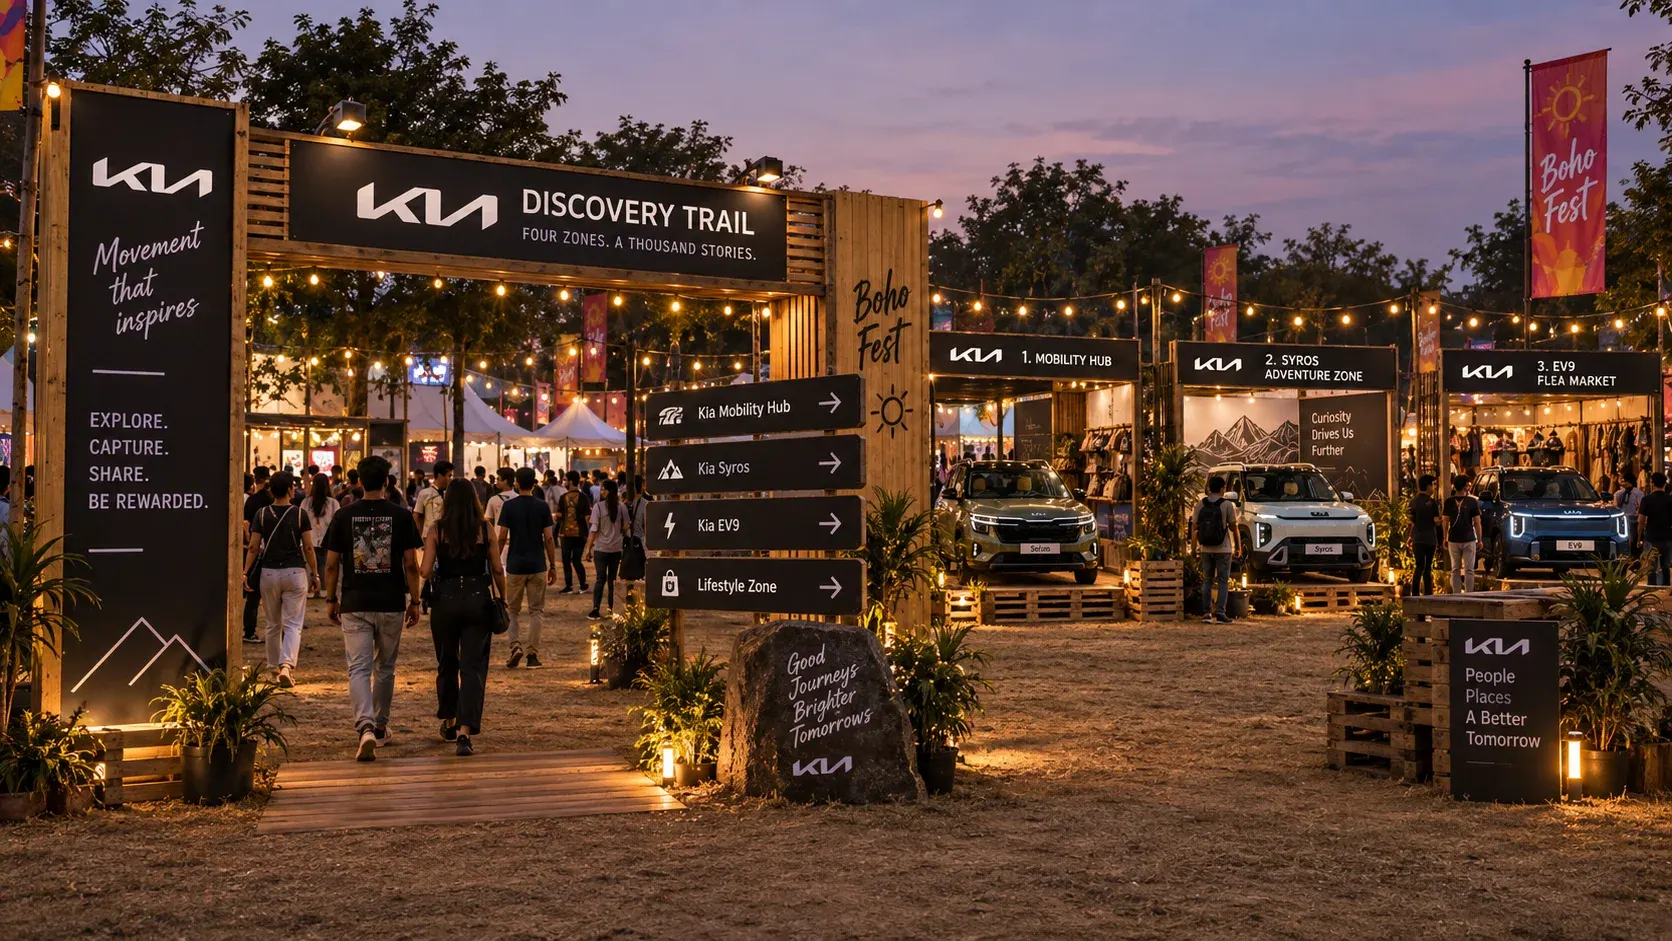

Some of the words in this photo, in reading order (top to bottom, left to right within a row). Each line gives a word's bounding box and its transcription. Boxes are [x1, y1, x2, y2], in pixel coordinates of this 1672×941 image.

[1540, 137, 1598, 194] Boho
[523, 188, 675, 228] DISCOVERY
[683, 205, 755, 236] TRAIL
[1543, 176, 1598, 233] Fest
[93, 221, 205, 275] Movement
[523, 227, 557, 242] FOUR
[563, 231, 609, 247] ZONES.
[615, 236, 623, 248] A
[629, 237, 696, 254] THOUSAND
[701, 244, 756, 260] STORIES.
[109, 268, 158, 306] that
[853, 268, 912, 324] Boho
[115, 298, 200, 340] inspires
[858, 317, 912, 371] Fest
[1022, 351, 1032, 365] 1.
[1036, 353, 1086, 365] MOBILITY
[1090, 356, 1111, 366] HUB
[1266, 354, 1276, 365] 2.
[1282, 355, 1319, 366] SYROS
[1538, 361, 1548, 371] 3.
[1553, 361, 1575, 371] EV9
[1265, 369, 1330, 380] ADVENTURE
[1334, 371, 1362, 381] ZONE
[1538, 375, 1565, 386] FLEA
[1570, 376, 1616, 386] MARKET
[699, 407, 715, 419] Kia
[720, 403, 764, 418] Mobility
[768, 400, 790, 413] Hub
[1312, 411, 1351, 424] Curiosity
[90, 412, 169, 429] EXPLORE.
[1312, 428, 1339, 440] Drives
[1342, 428, 1354, 438] Us
[89, 438, 169, 456] CAPTURE.
[1312, 445, 1344, 456] Further
[89, 465, 149, 483] SHARE.
[699, 462, 715, 474] Kia
[719, 461, 749, 476] Syros
[89, 494, 109, 509] BE
[117, 494, 208, 509] REWARDED.
[699, 519, 714, 531] Kia
[719, 519, 739, 531] EV9
[1314, 545, 1333, 553] Syros
[698, 578, 744, 595] Lifestyle
[748, 579, 777, 593] Zone
[787, 643, 826, 676] Good
[789, 663, 860, 700] Journeys
[1466, 668, 1515, 686] People
[1466, 688, 1511, 704] Places
[793, 690, 856, 724] Brighter
[1466, 710, 1476, 724] A
[1482, 711, 1527, 726] Better
[789, 708, 873, 749] Tomorrows
[1466, 731, 1540, 748] Tomorrow
